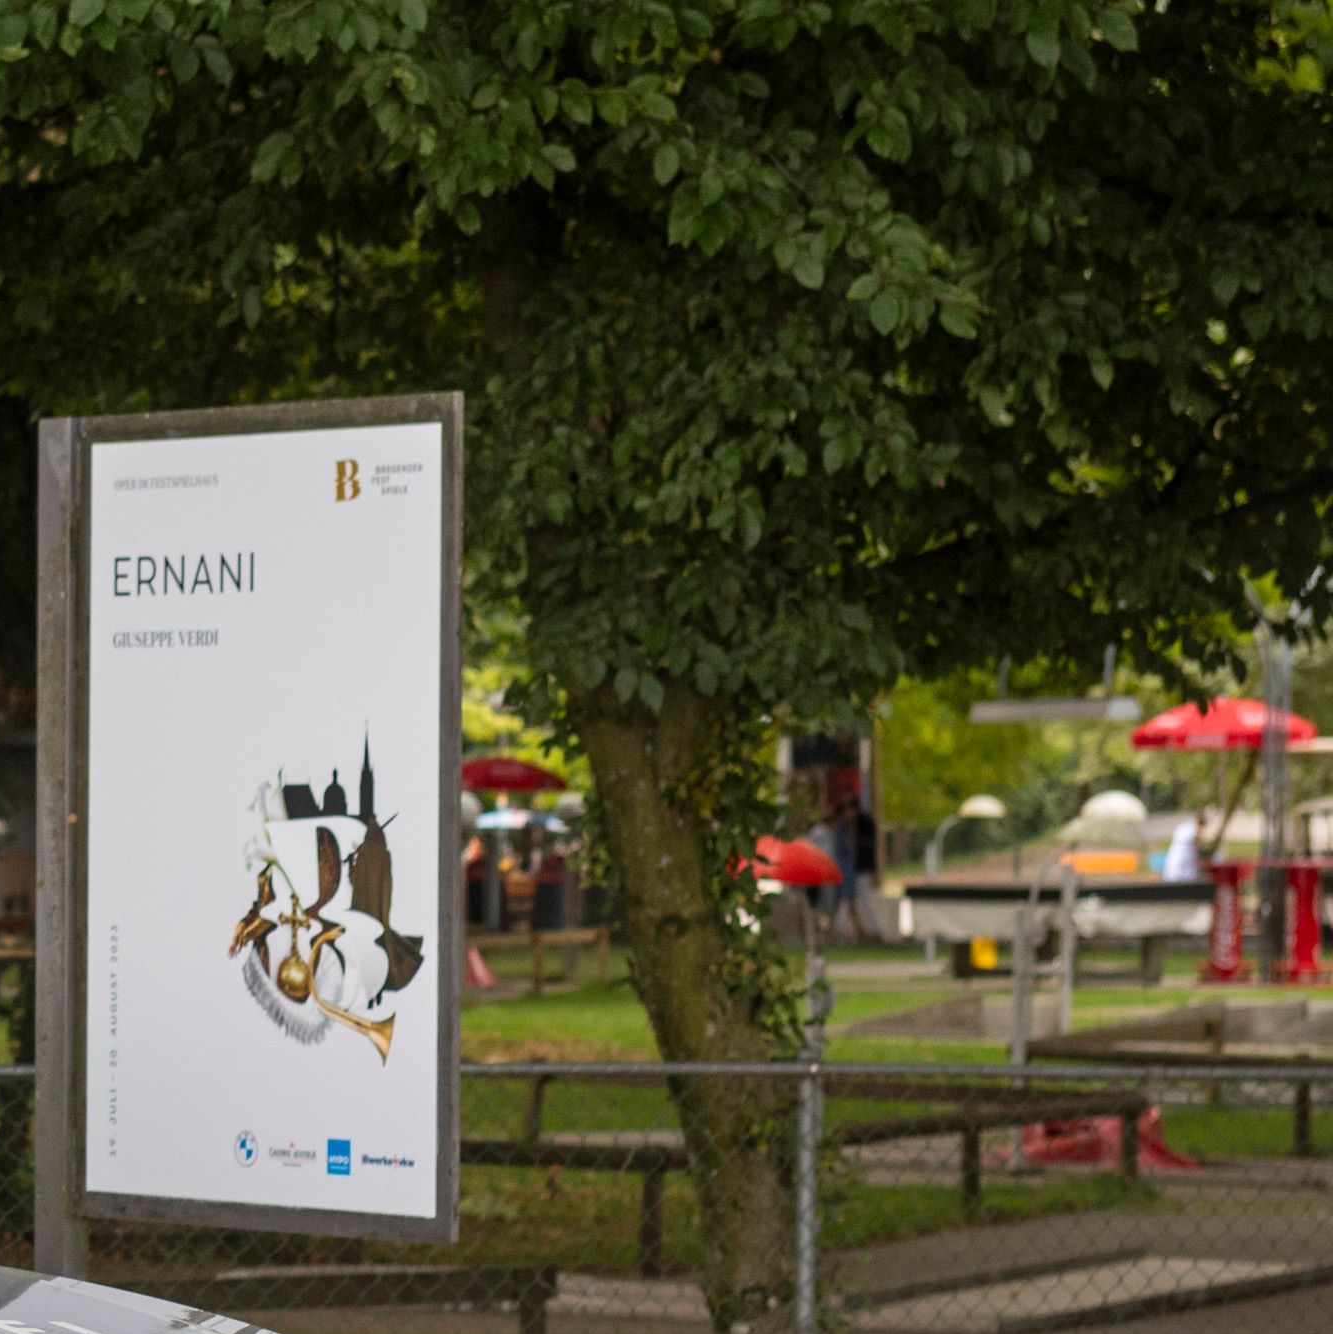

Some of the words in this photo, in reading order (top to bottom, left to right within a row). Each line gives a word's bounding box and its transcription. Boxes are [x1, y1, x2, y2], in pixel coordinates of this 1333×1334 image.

[113, 551, 256, 597] ERNANI
[112, 630, 175, 649] GIUSEPPE
[178, 628, 219, 647] VERDI
[109, 970, 119, 1036] AUGUST
